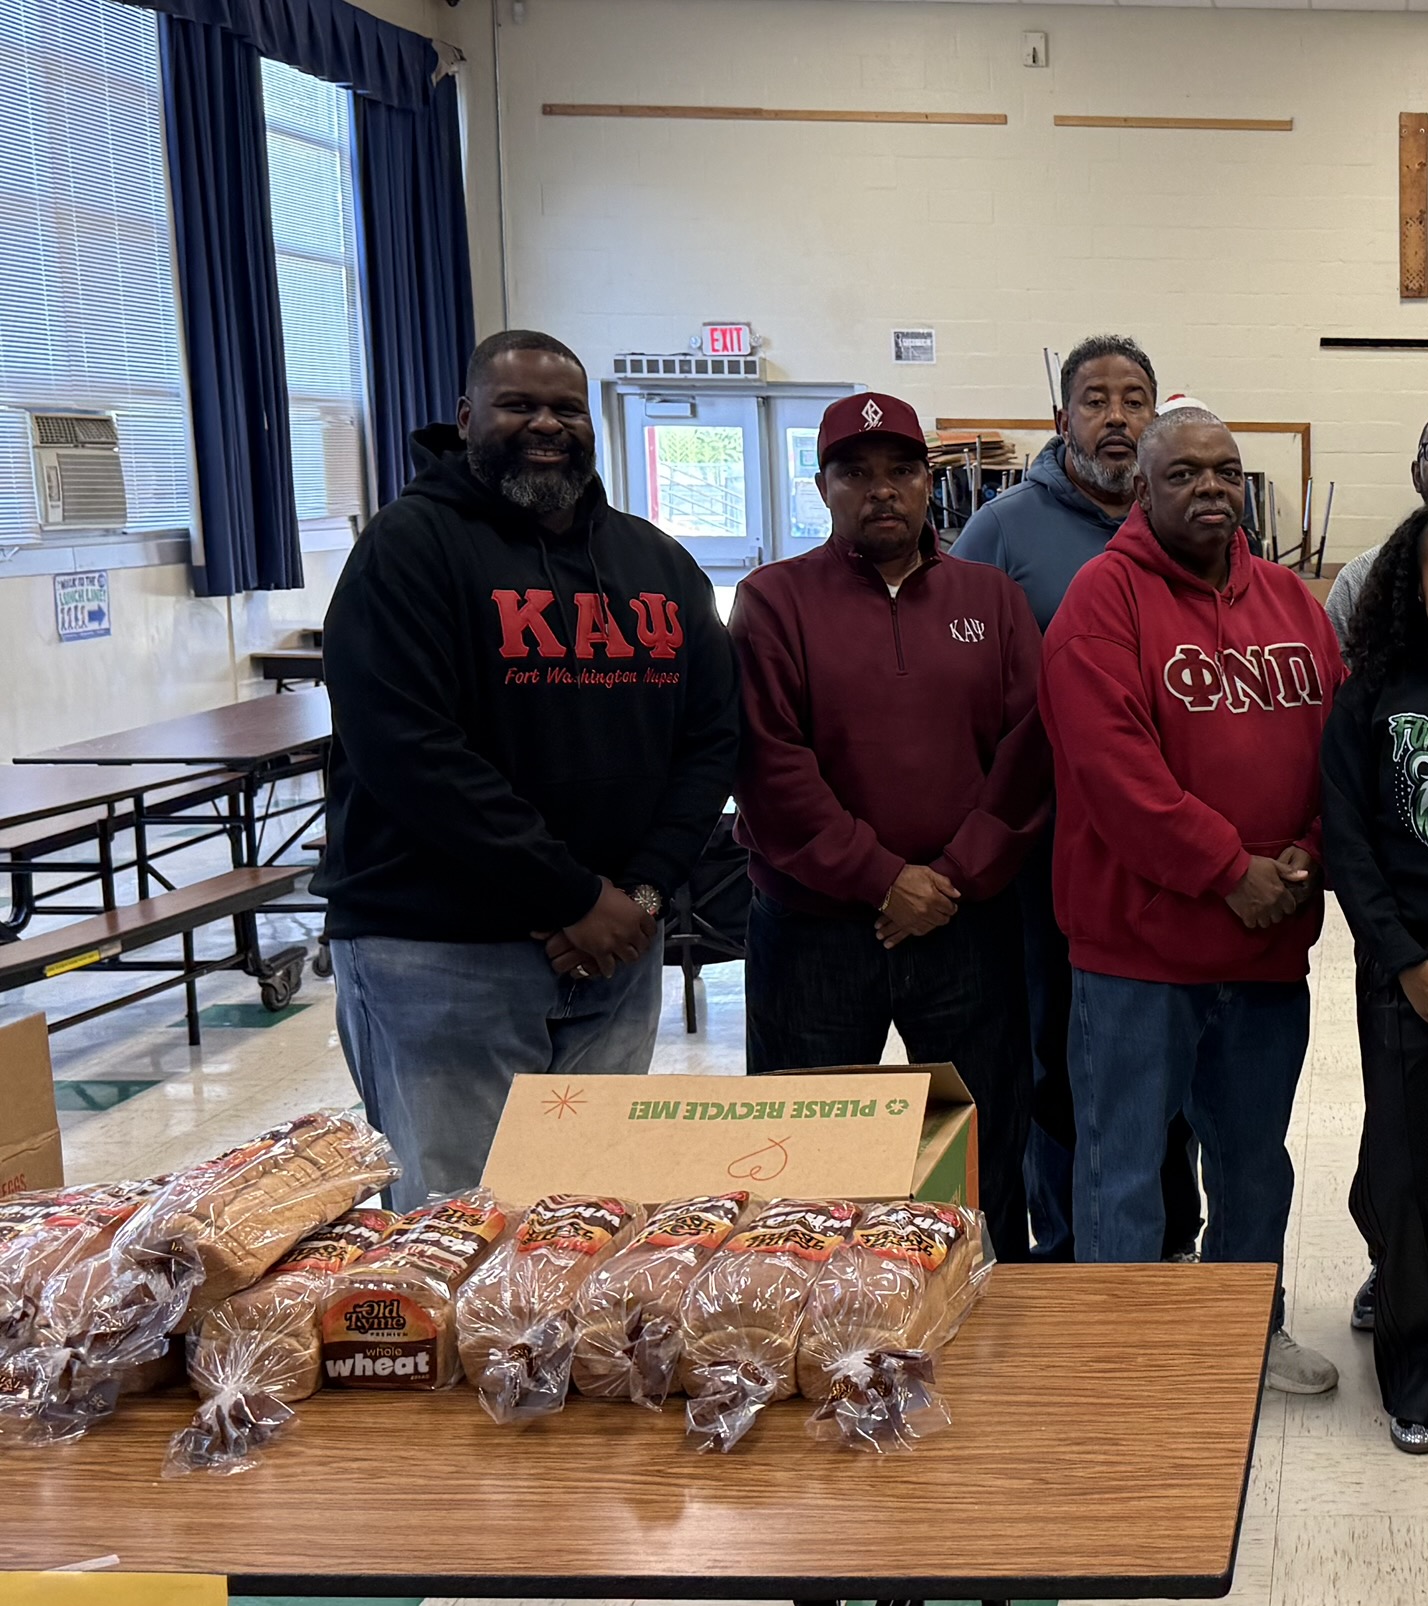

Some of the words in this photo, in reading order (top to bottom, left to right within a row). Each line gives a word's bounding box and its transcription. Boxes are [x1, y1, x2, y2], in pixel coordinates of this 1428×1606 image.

[709, 327, 744, 353] EXIT
[504, 667, 539, 685] Fort
[546, 667, 637, 689] Wahington
[642, 667, 681, 688] Nupes
[627, 1101, 681, 1120] ME!
[682, 1100, 786, 1120] RECYCLE
[790, 1099, 877, 1119] PLEASE
[1, 1173, 27, 1198] EGGS
[355, 1301, 399, 1318] Old
[347, 1314, 405, 1331] Tyme
[366, 1346, 402, 1356] whole
[325, 1351, 430, 1378] wheat
